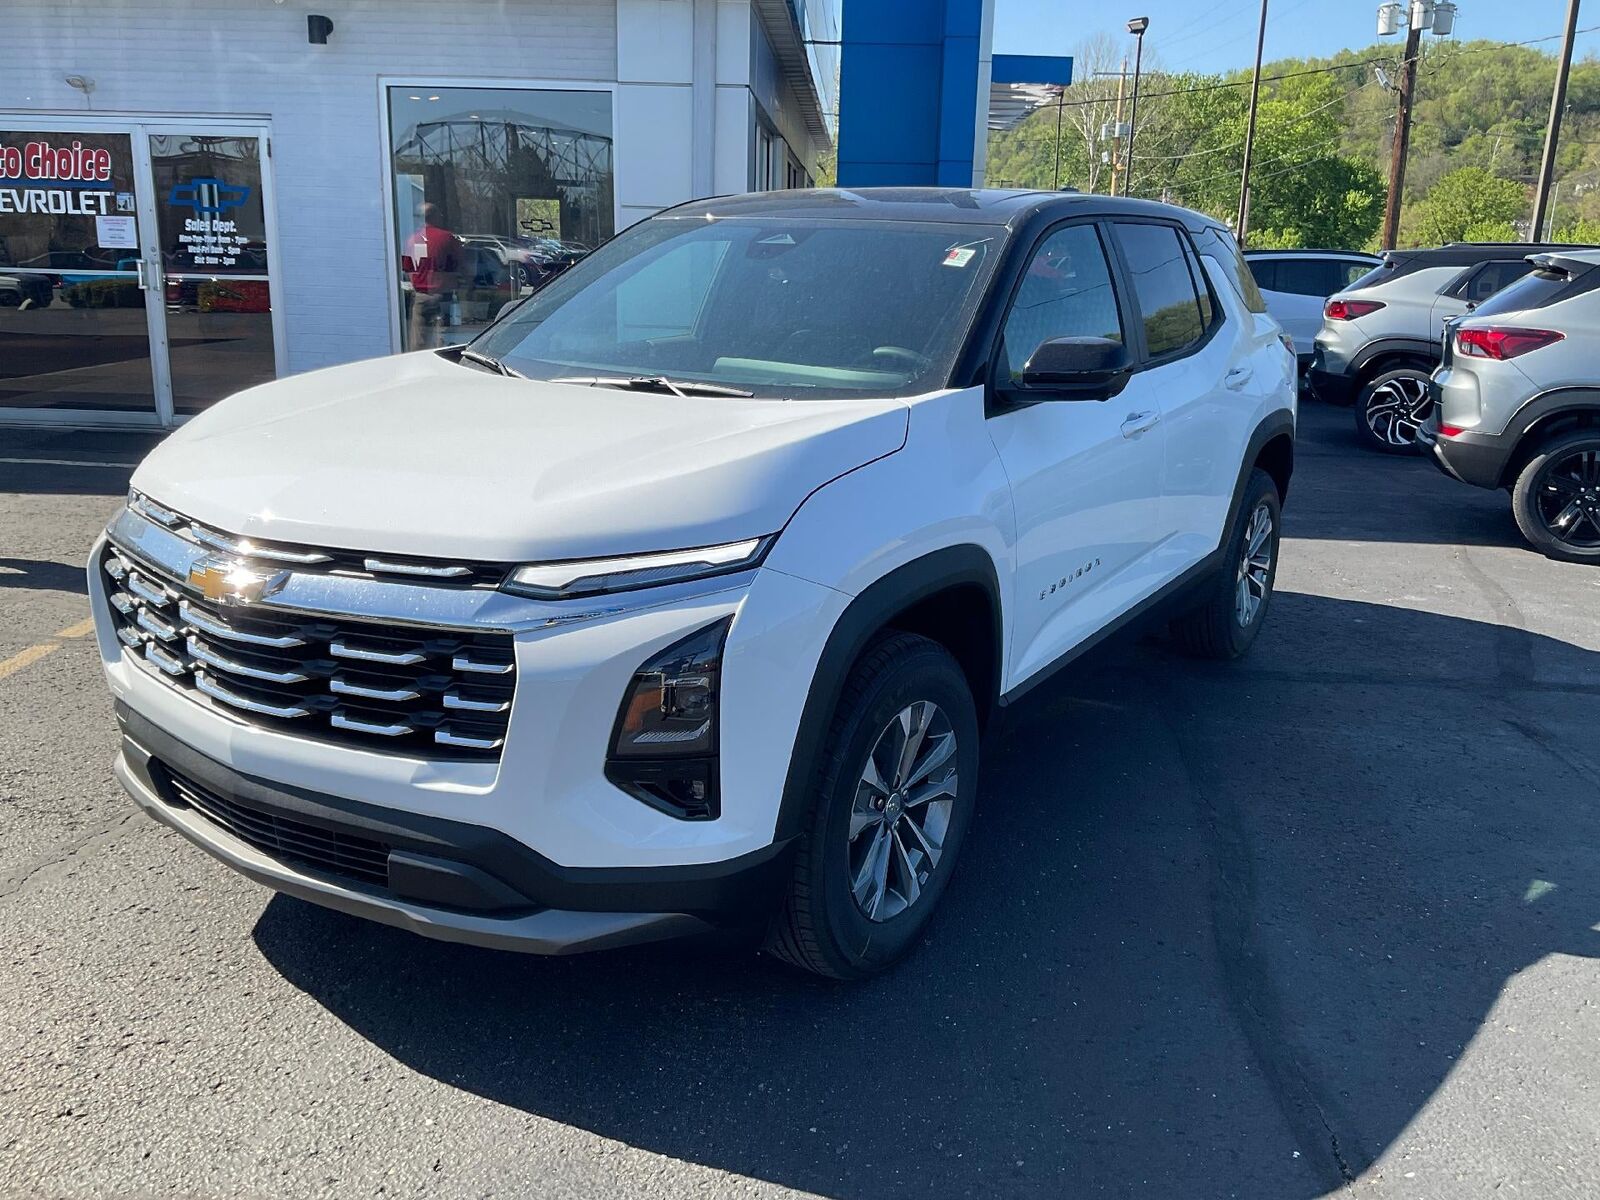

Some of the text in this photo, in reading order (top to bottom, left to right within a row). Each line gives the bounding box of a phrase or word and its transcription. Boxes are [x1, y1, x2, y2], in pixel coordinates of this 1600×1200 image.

[25, 141, 111, 181] Choice
[0, 189, 110, 215] EVROLET
[185, 219, 237, 233] Sales Dept.
